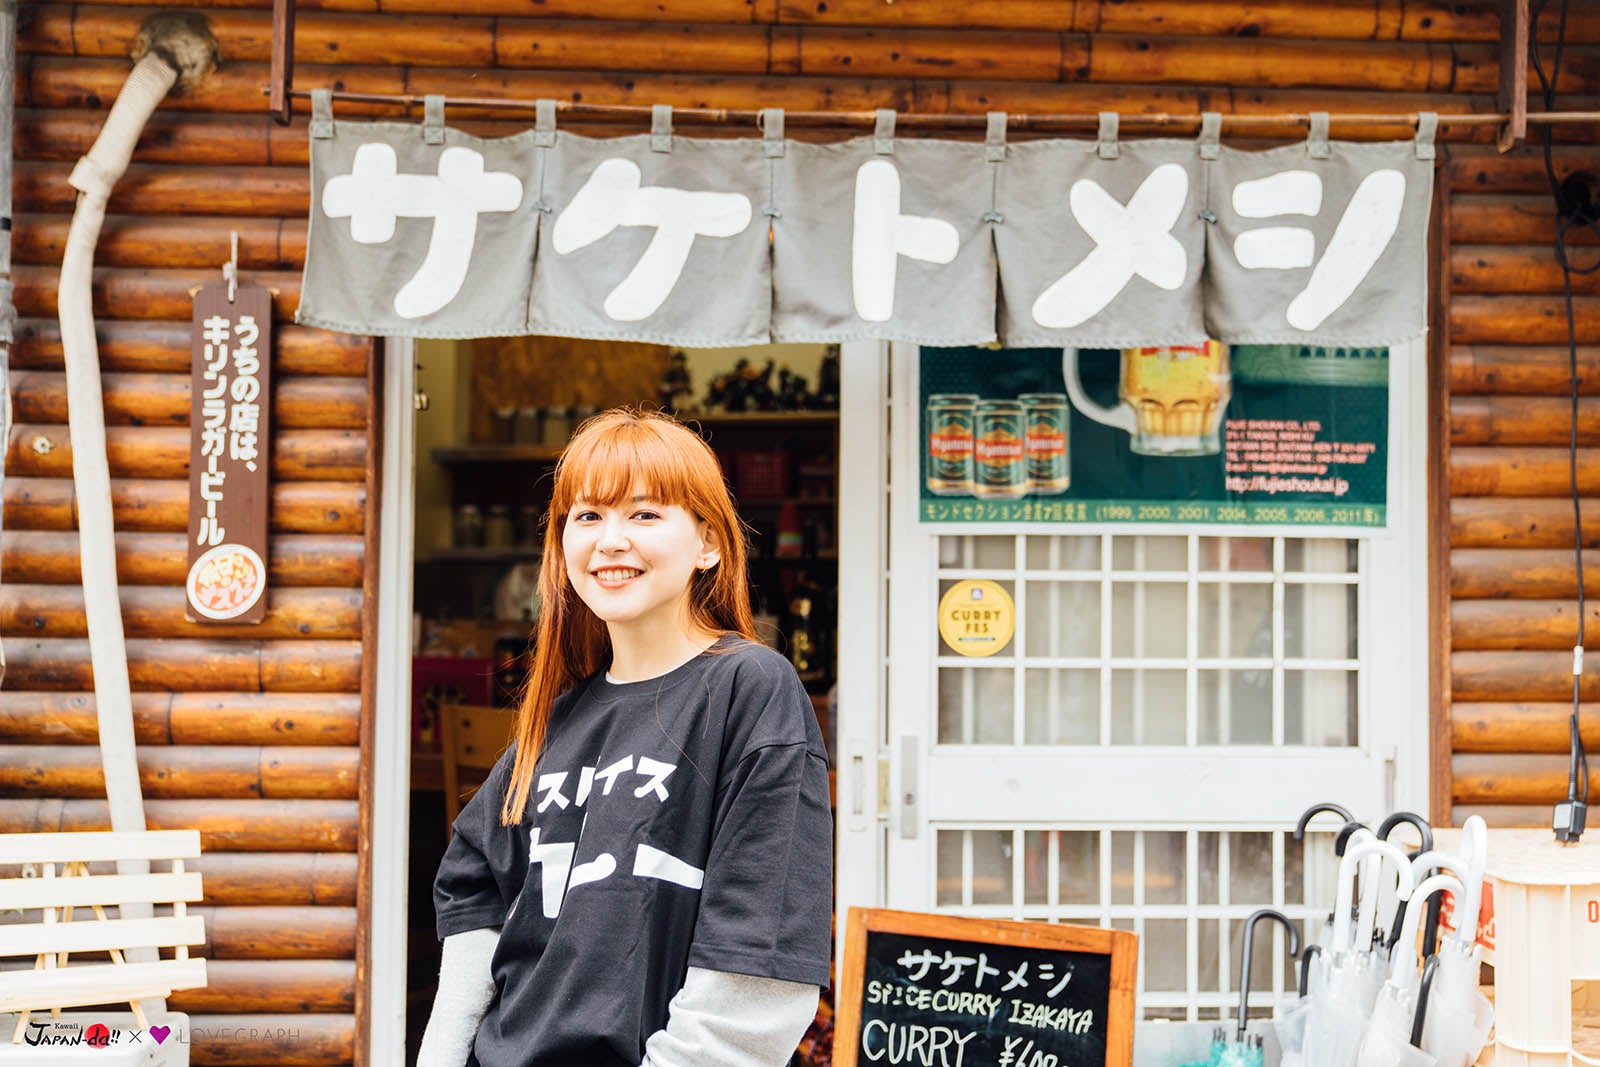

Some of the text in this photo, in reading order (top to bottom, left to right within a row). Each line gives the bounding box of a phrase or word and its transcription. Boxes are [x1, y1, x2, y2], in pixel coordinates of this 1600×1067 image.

[321, 141, 1406, 331] サケトメシ
[229, 315, 261, 471] うちの店は、
[197, 315, 230, 546] キリンラガービール
[951, 609, 1001, 621] CURRY
[897, 948, 1073, 998] サケトメシ
[1008, 998, 1093, 1035] IZAKAYA
[862, 1018, 977, 1067] CURRY
